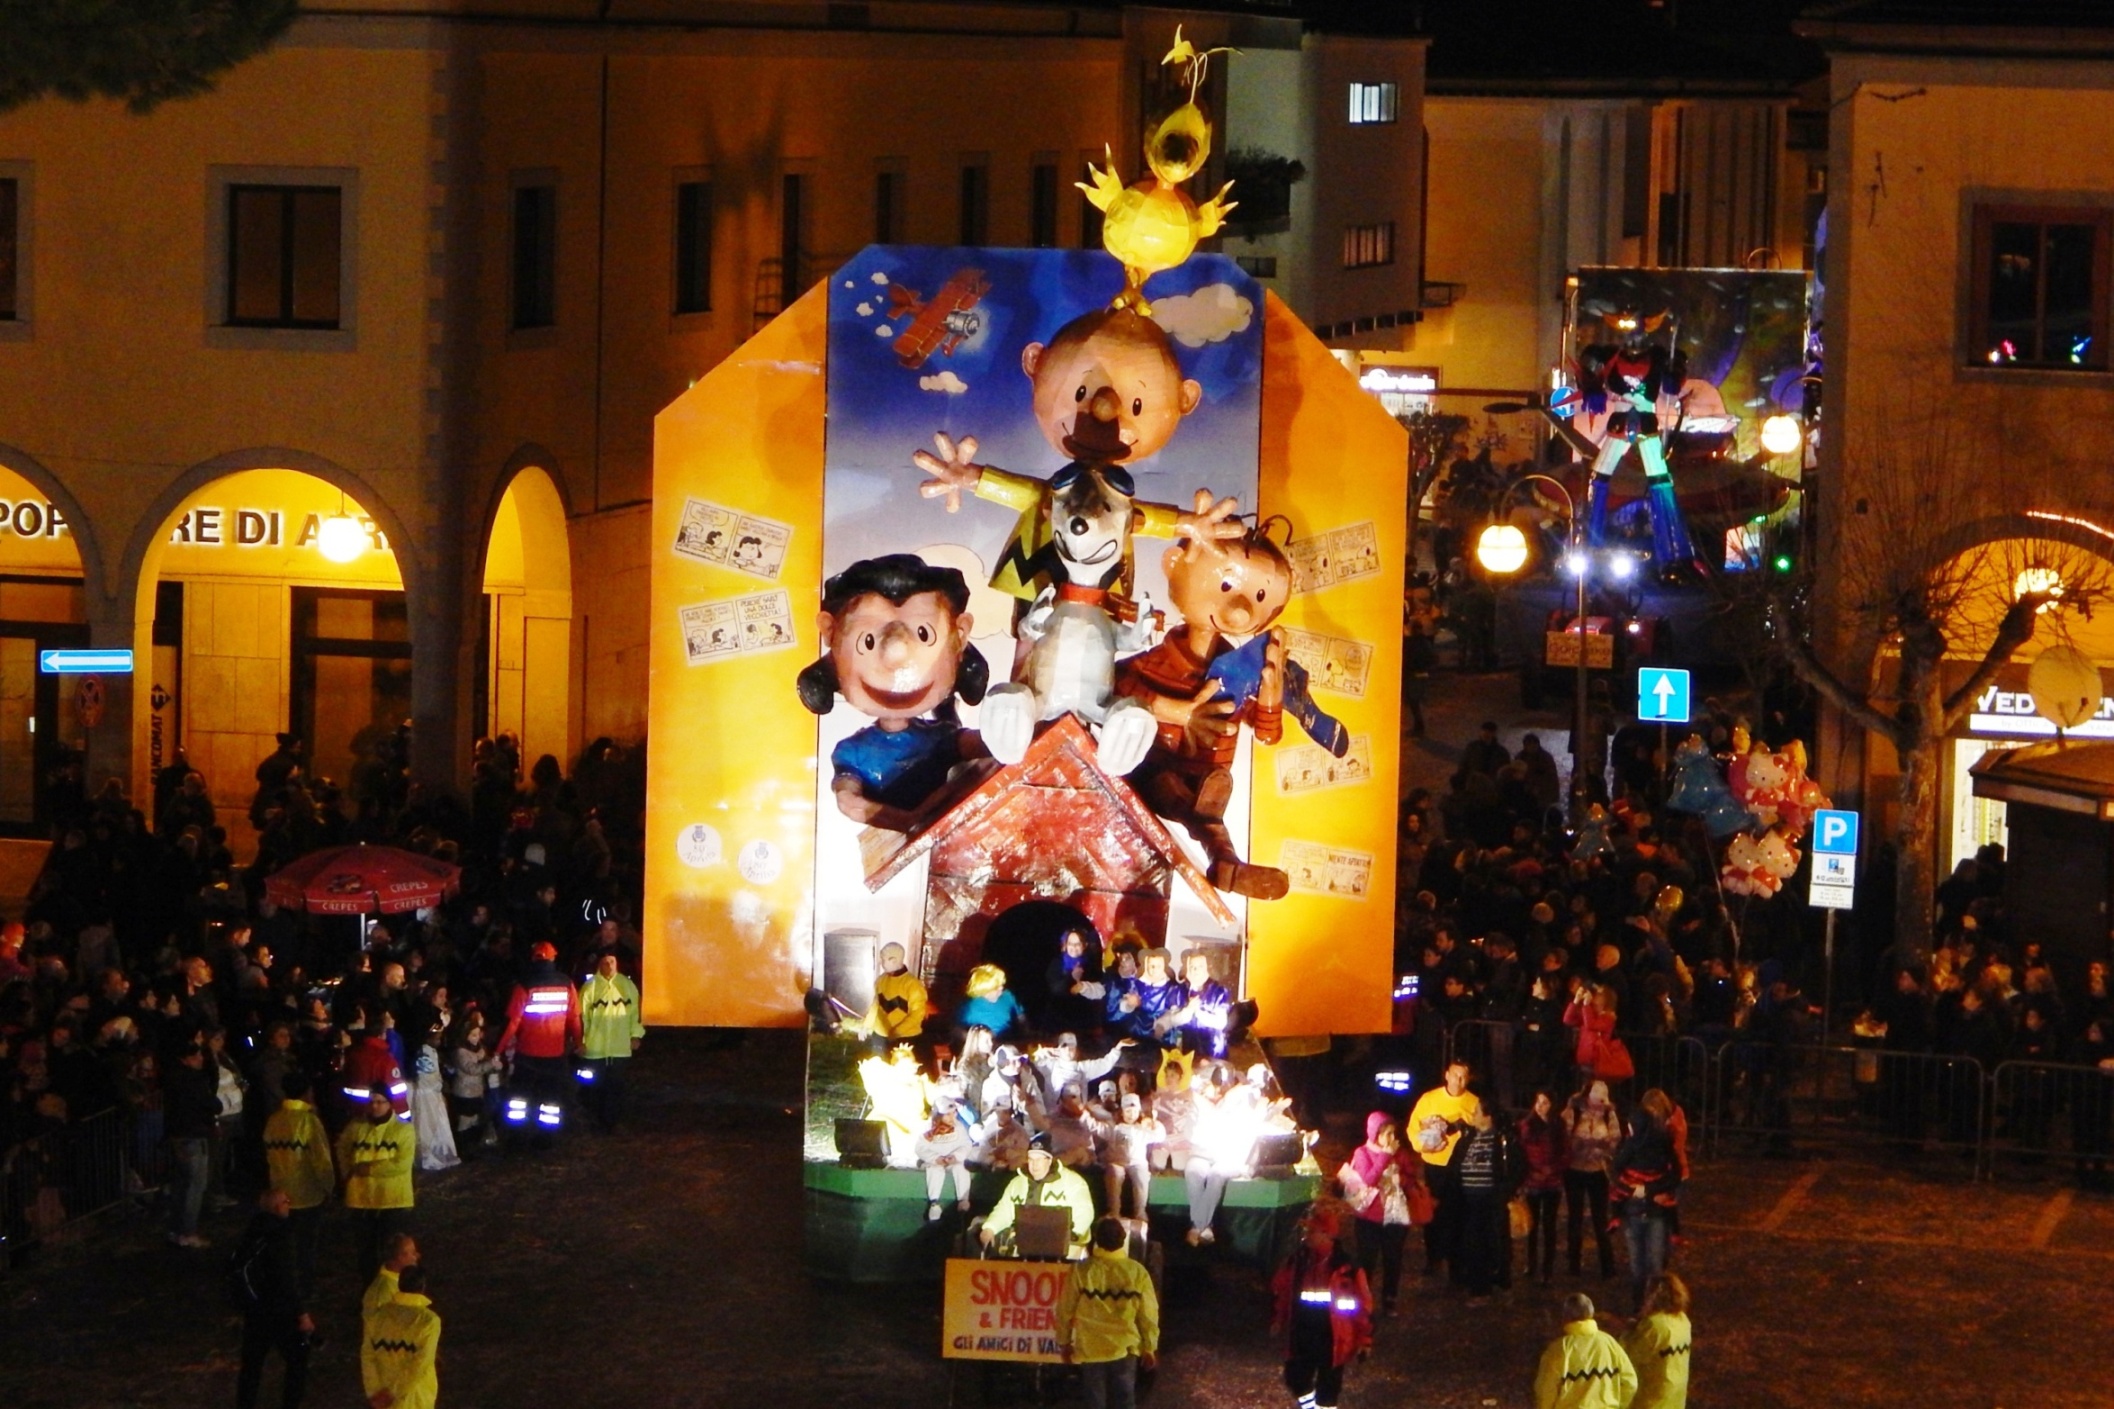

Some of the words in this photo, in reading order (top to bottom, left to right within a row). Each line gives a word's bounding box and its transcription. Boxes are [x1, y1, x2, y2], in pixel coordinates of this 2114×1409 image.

[238, 510, 280, 546] DI
[1823, 816, 1848, 847] P
[979, 1311, 993, 1329] &
